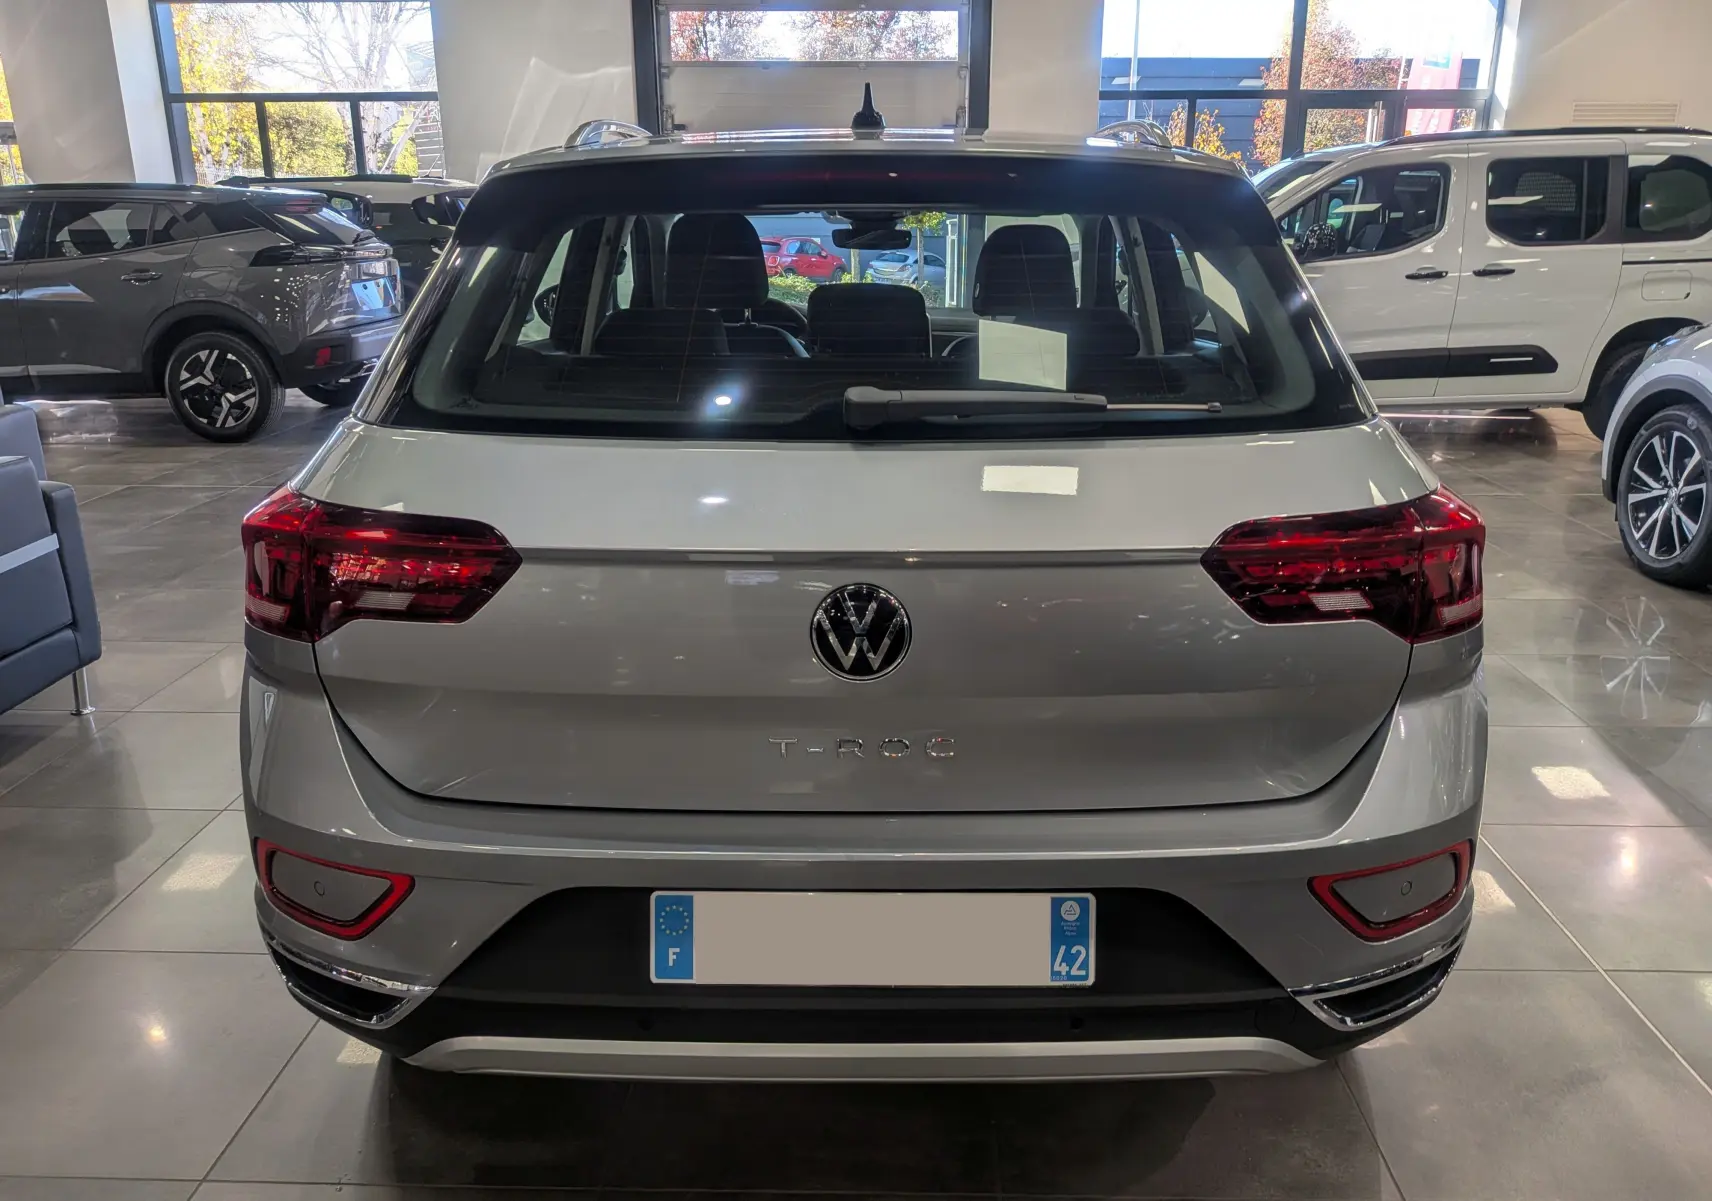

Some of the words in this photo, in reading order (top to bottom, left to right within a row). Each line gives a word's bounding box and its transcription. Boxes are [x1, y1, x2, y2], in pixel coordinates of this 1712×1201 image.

[768, 736, 955, 759] T-ROC
[668, 947, 681, 967] F
[1053, 944, 1087, 976] 42
